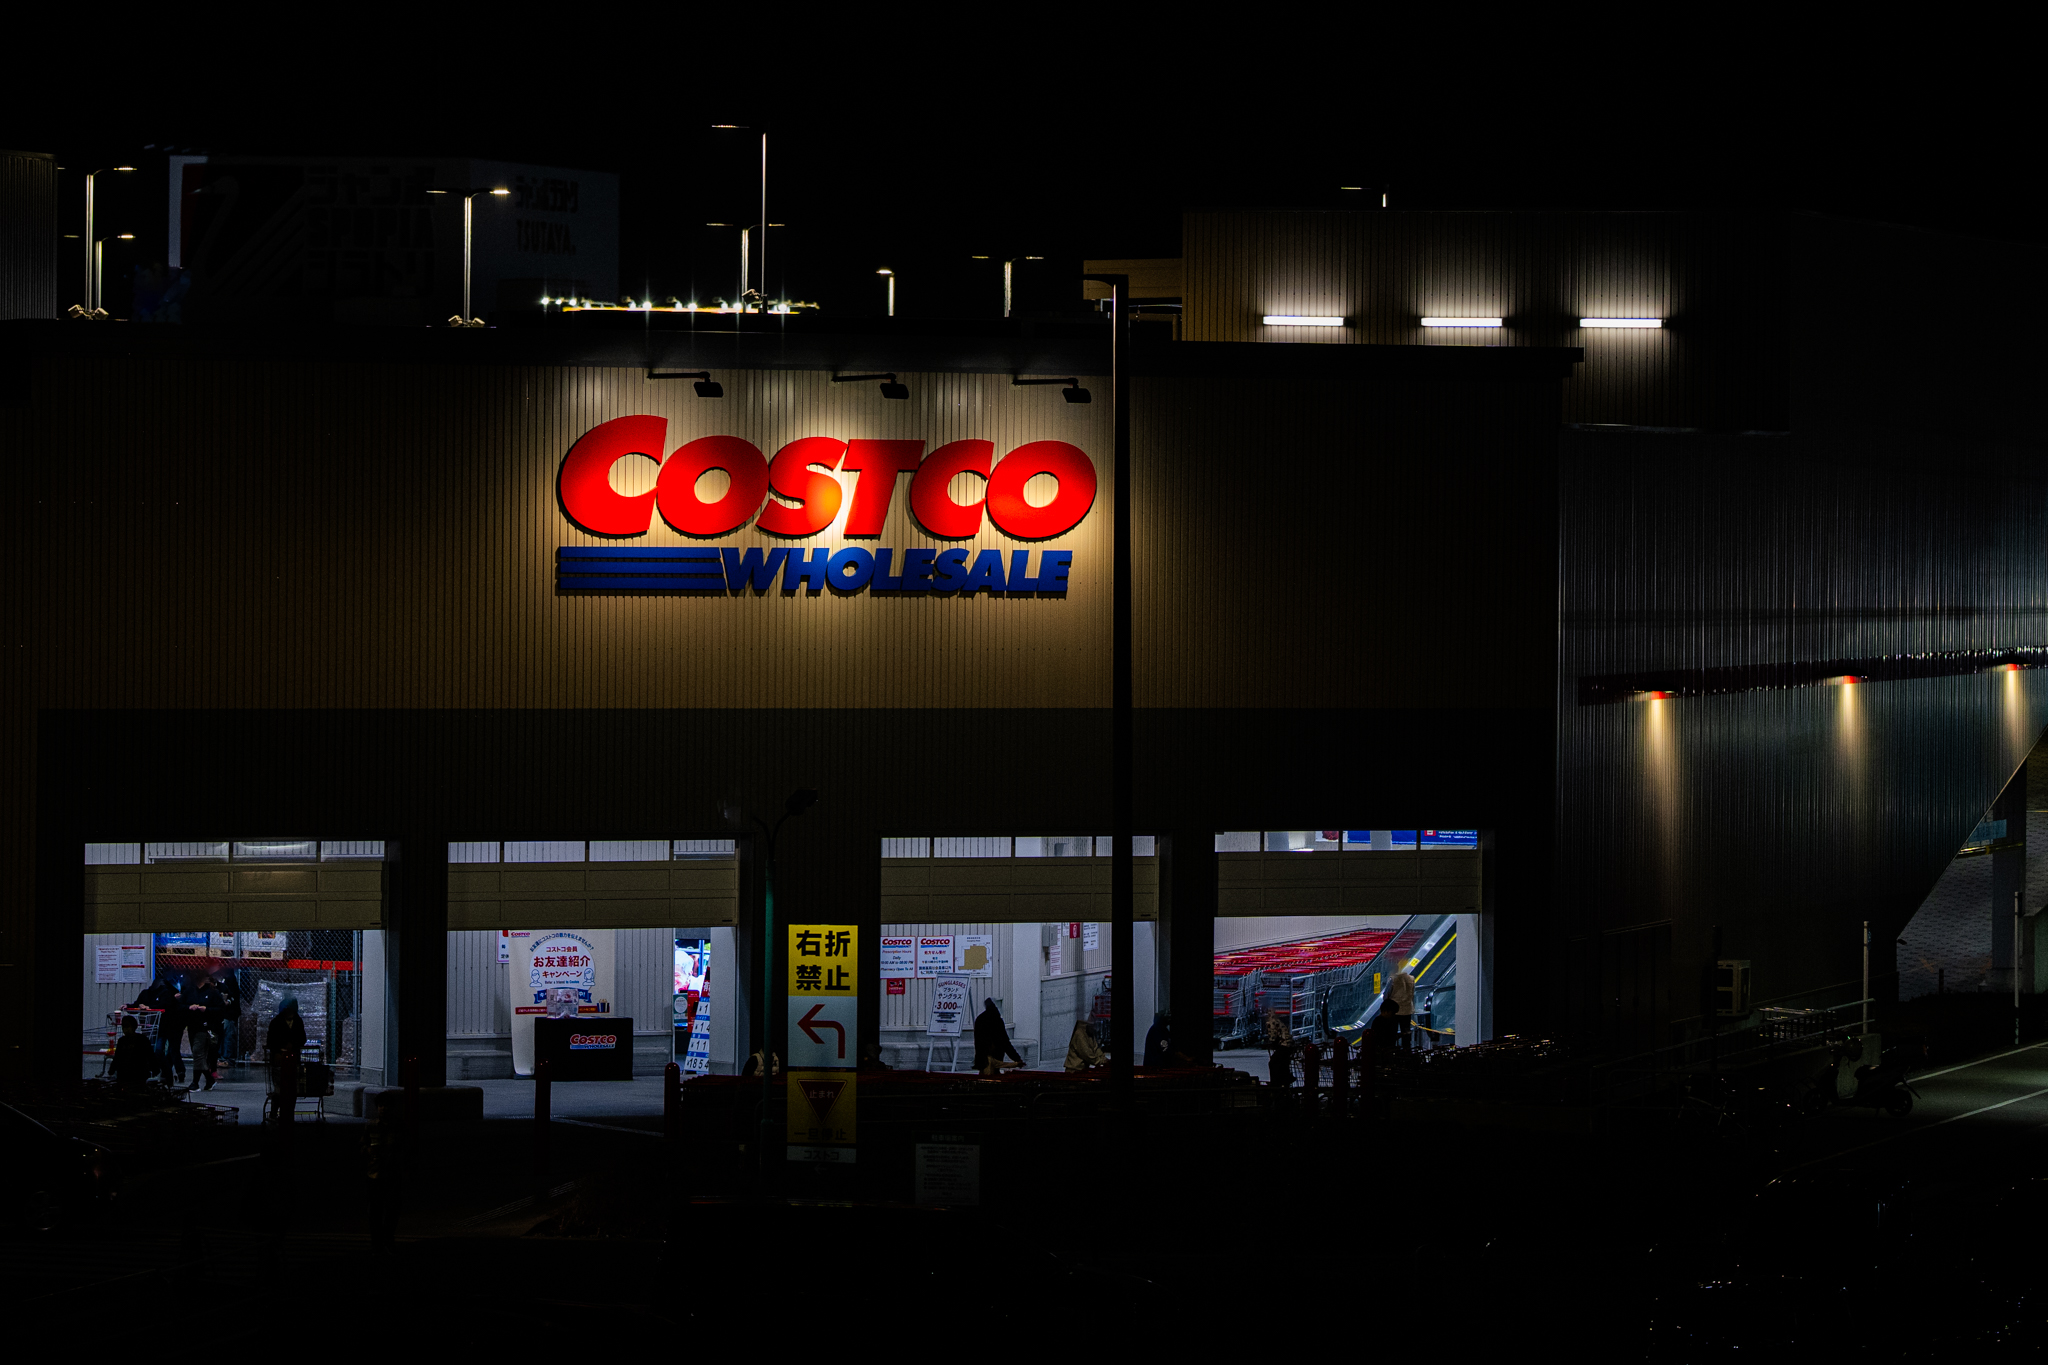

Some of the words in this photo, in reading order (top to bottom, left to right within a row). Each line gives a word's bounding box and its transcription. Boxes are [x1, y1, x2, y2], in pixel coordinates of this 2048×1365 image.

[308, 207, 435, 248] SPOPIA
[559, 414, 1098, 540] COSTCO
[720, 546, 1074, 593] WHOLESALE
[796, 930, 851, 957] 右折
[533, 955, 591, 968] お友達紹介
[796, 964, 850, 991] 禁止
[938, 980, 966, 989] SUNGLASSES
[570, 1034, 616, 1044] COSTCO
[809, 1090, 835, 1099] 止まれ
[794, 1128, 847, 1141] 一旦停止
[803, 1150, 840, 1161] コストコ
